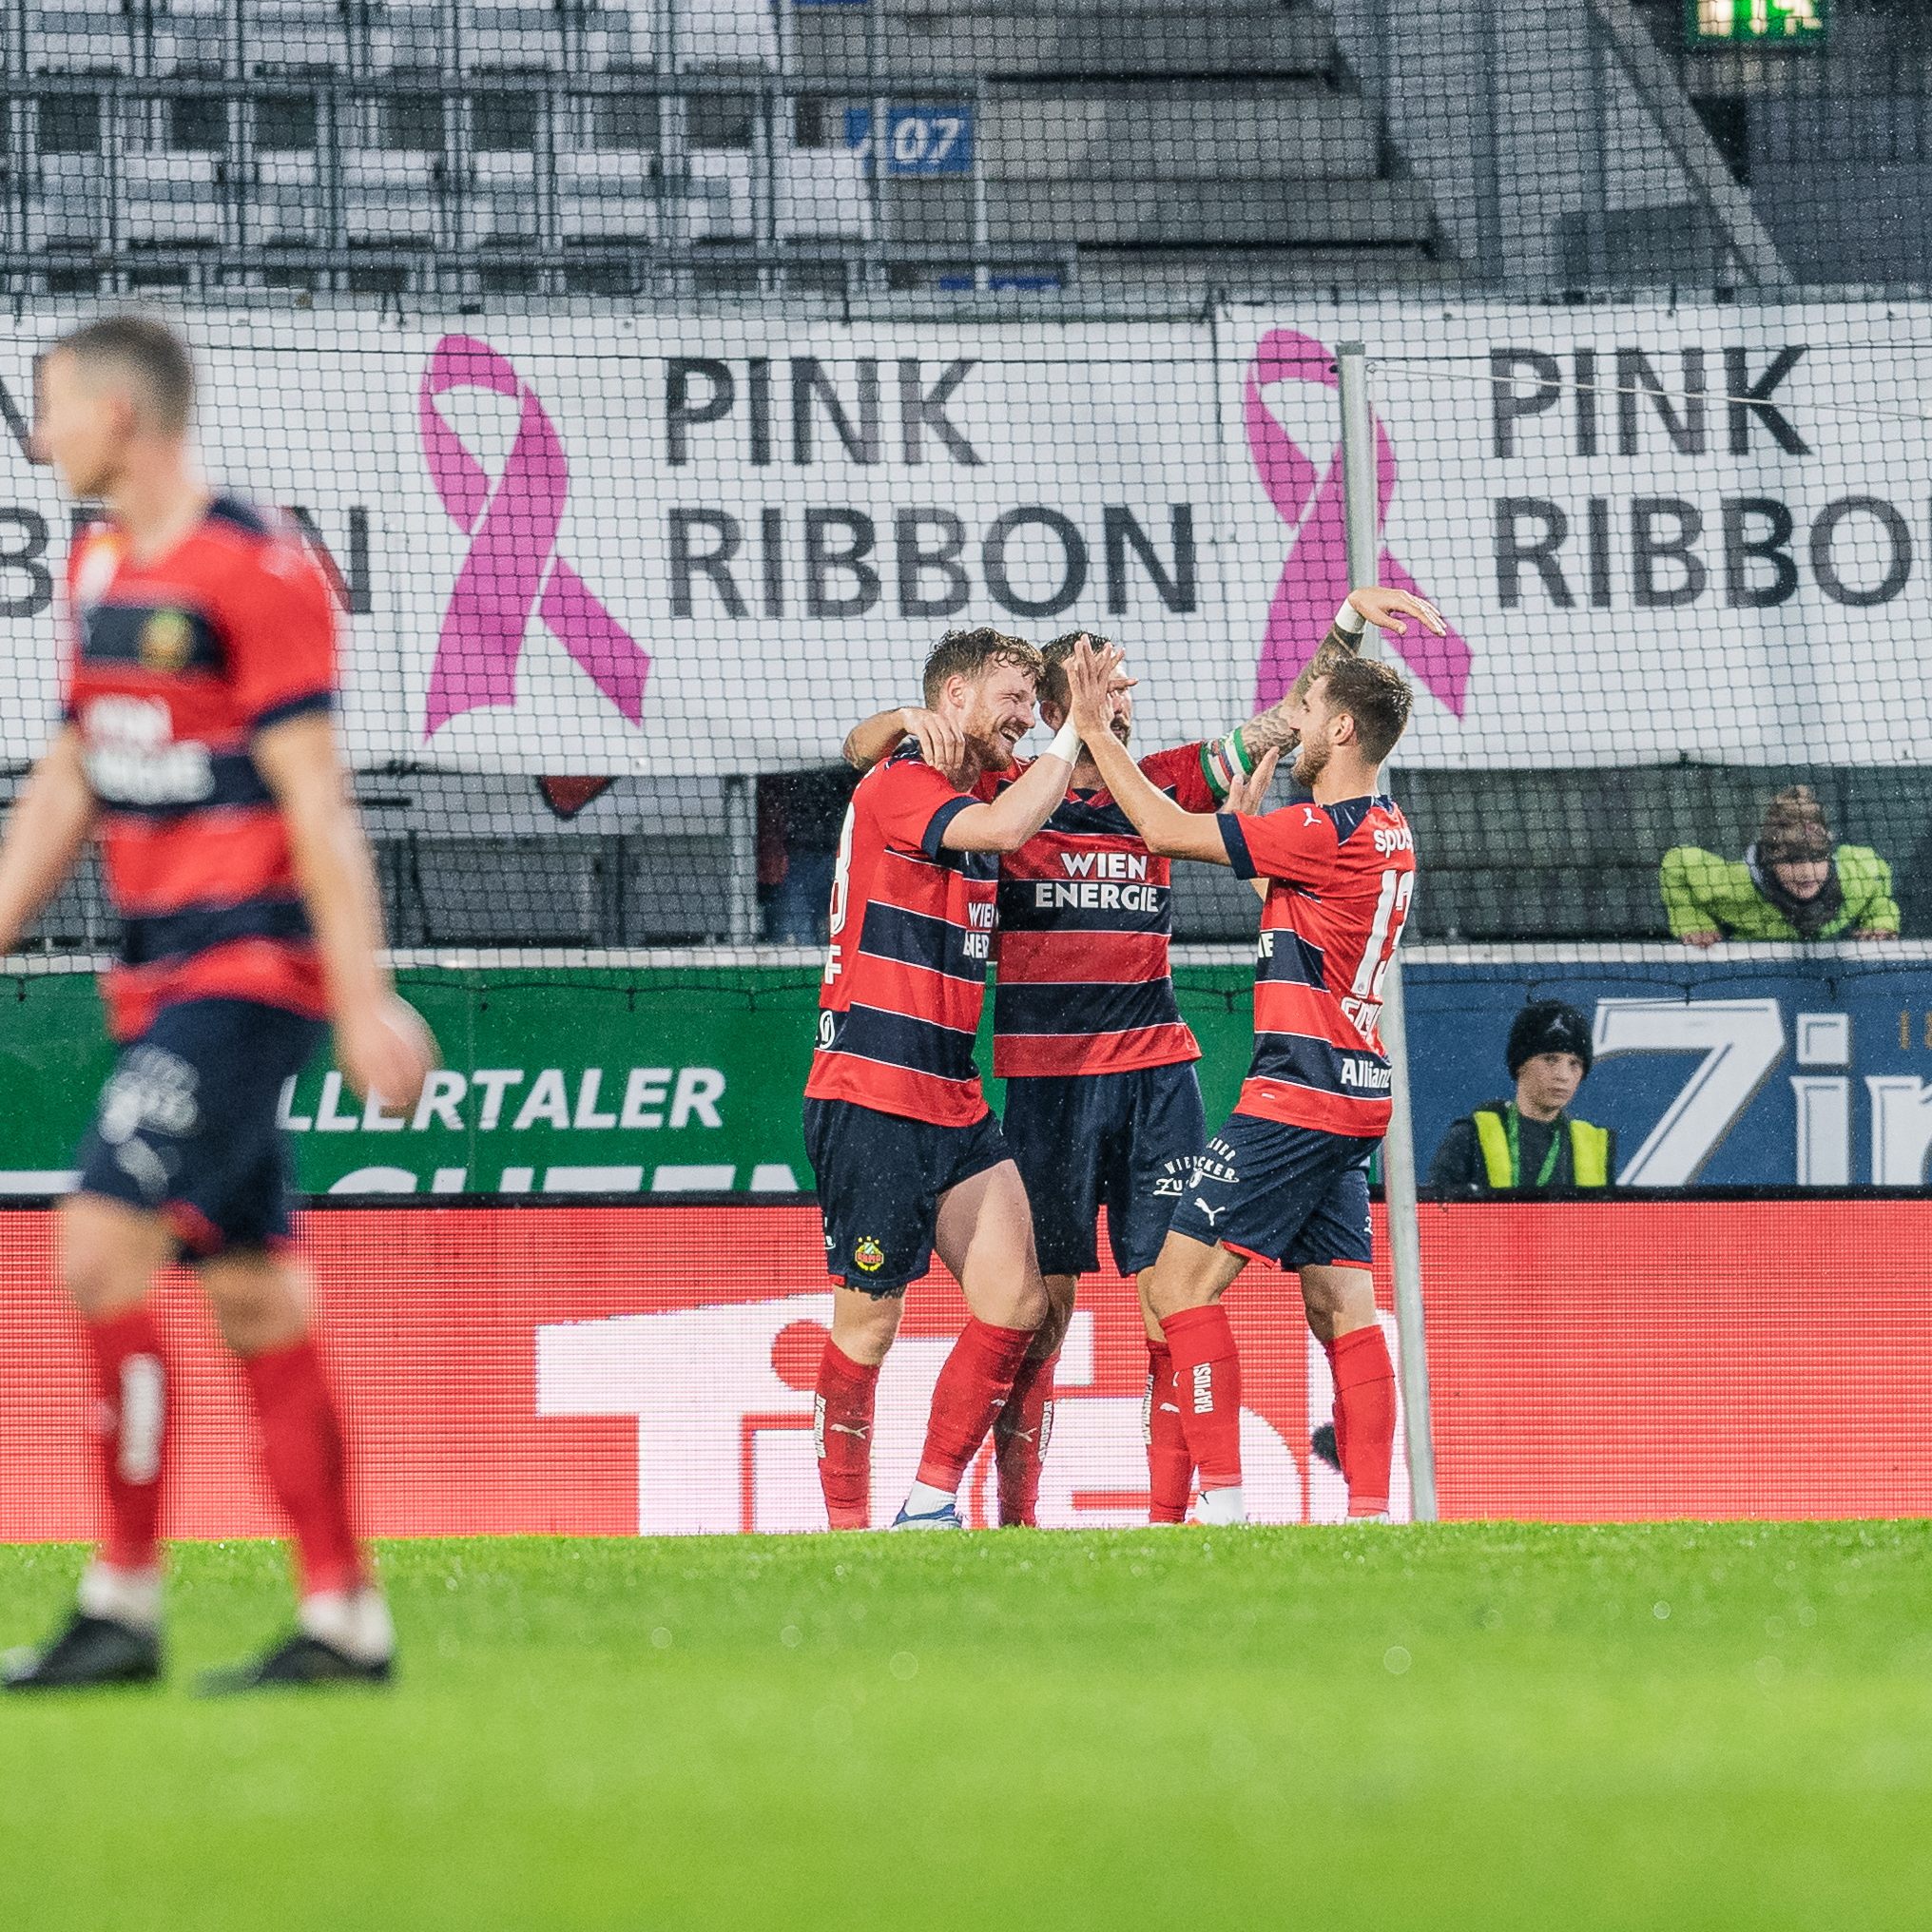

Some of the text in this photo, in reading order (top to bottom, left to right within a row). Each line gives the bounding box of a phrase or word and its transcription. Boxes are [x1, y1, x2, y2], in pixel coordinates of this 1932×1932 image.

[893, 117, 960, 164] 07
[667, 357, 986, 466] PINK
[1489, 345, 1813, 458] PINK
[667, 503, 1197, 618] RIBBON
[1495, 494, 1932, 609] RIBBO
[1035, 882, 1159, 913] ENERGIE
[1060, 852, 1148, 880] WIEN
